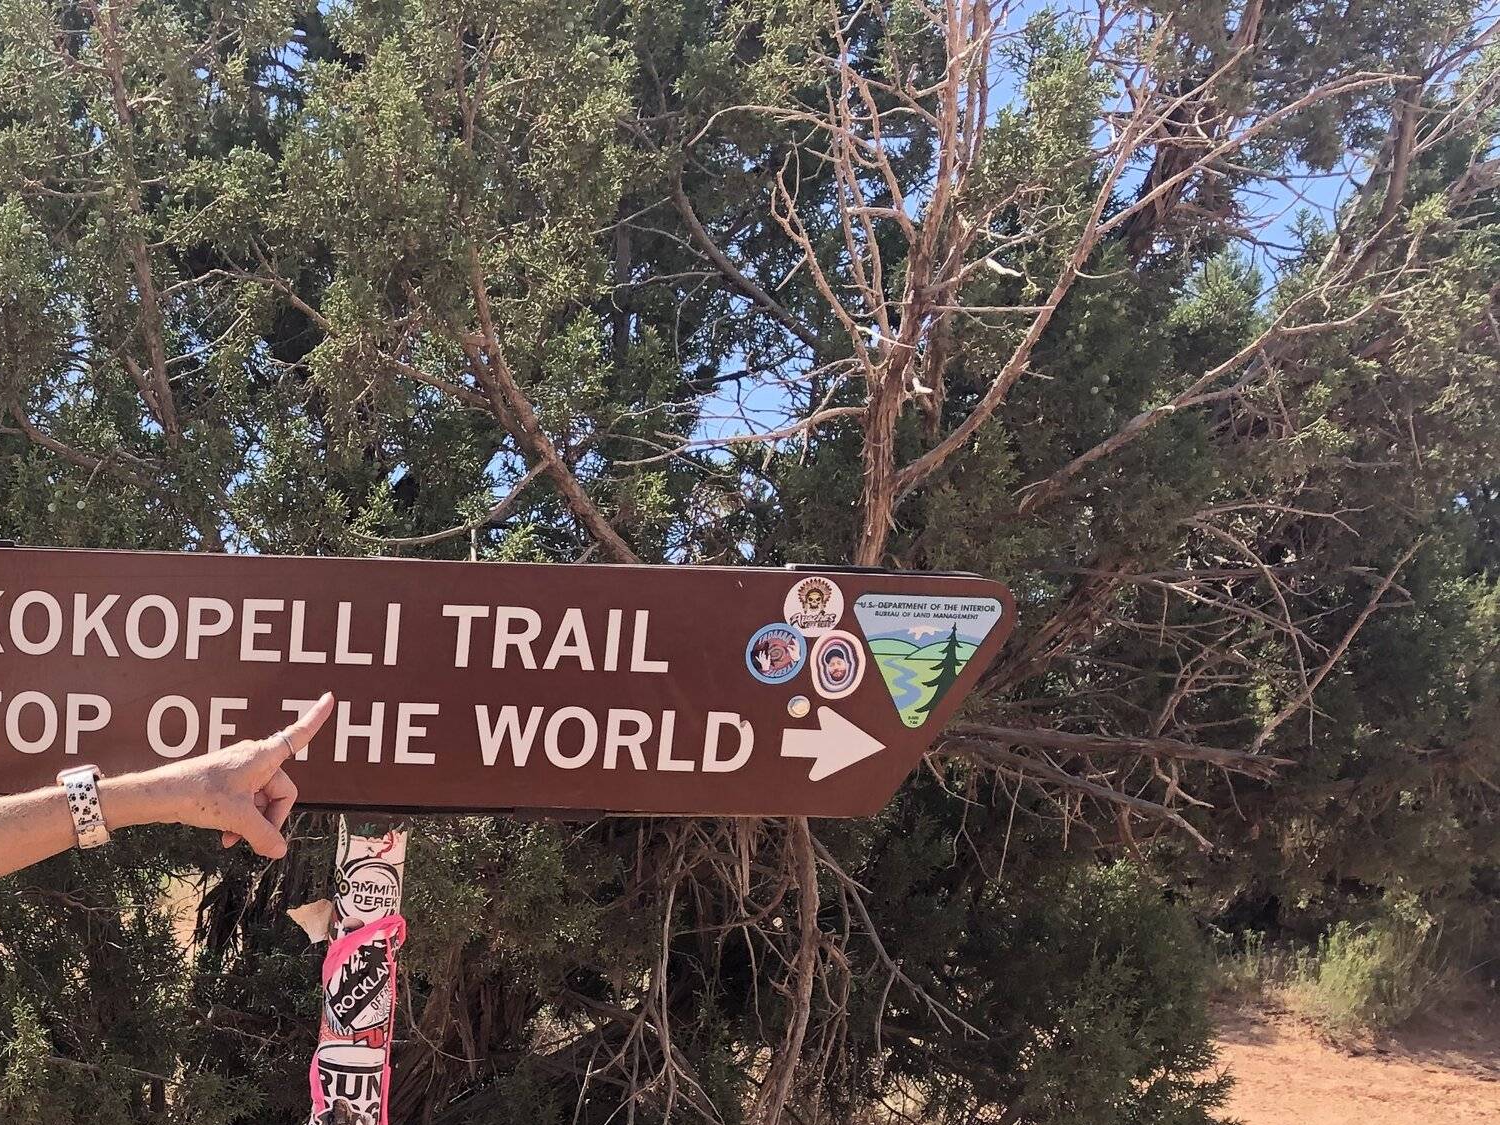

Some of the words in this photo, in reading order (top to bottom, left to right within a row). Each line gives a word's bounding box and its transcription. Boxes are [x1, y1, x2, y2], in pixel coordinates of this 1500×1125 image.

[877, 602, 927, 610] DEPARTMENT
[960, 604, 996, 612] INTERIOR
[442, 604, 669, 673] TRAIL
[146, 695, 248, 758] OF
[282, 699, 440, 764] THE
[474, 704, 755, 773] WORLD
[353, 894, 399, 908] DEREK
